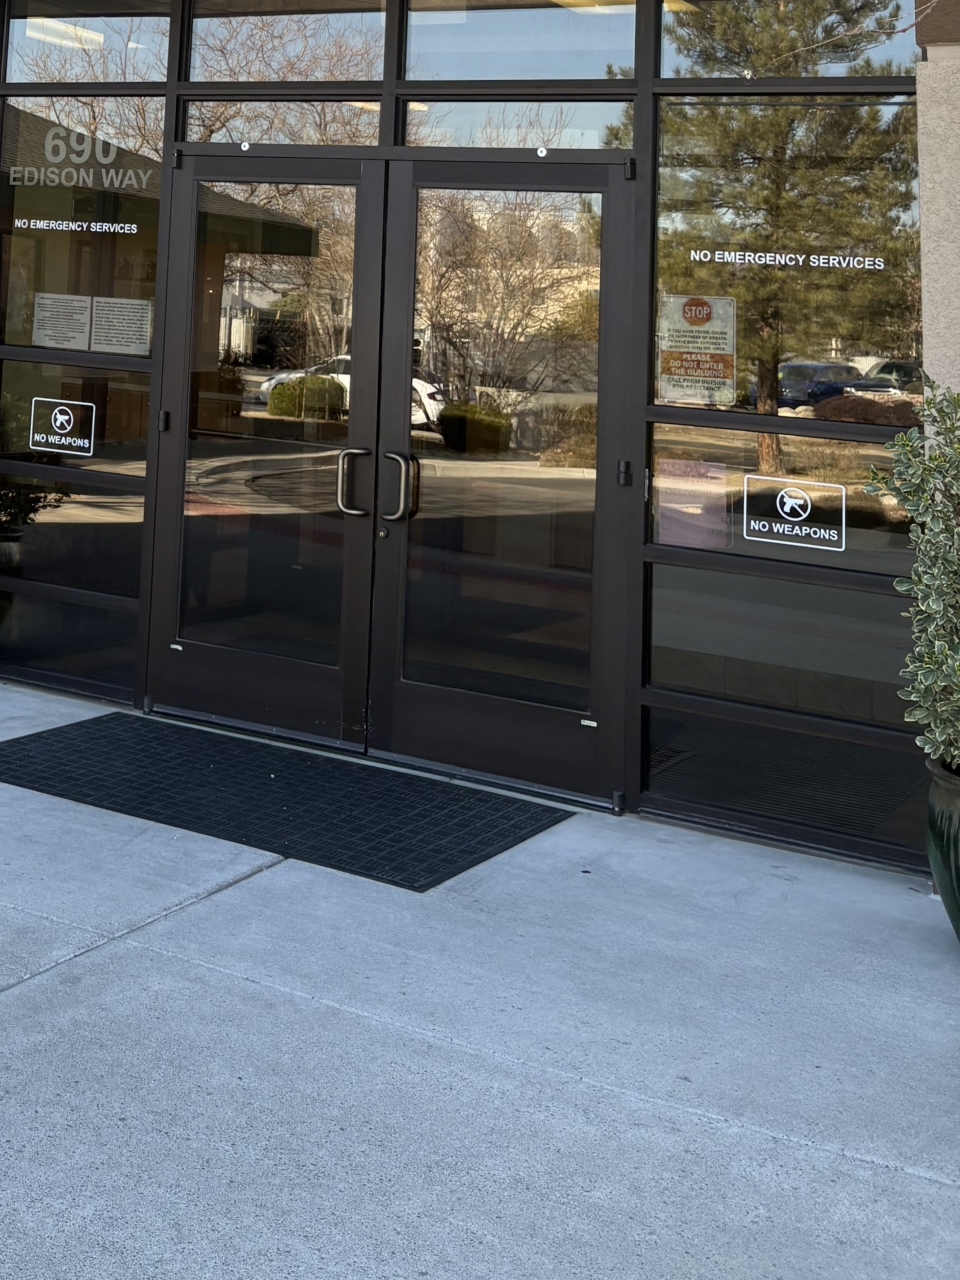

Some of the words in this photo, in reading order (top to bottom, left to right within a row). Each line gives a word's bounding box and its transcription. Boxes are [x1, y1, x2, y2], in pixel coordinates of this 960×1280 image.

[44, 126, 118, 165] 690
[9, 166, 93, 188] EDISON
[101, 168, 153, 189] WAY
[14, 219, 28, 229] NO
[30, 220, 88, 231] EMERGENCY
[90, 222, 138, 234] SERVICES
[690, 250, 711, 262] NO
[714, 250, 806, 266] EMERGENCY
[809, 255, 885, 270] SERVICES
[684, 306, 710, 318] STOP
[683, 353, 711, 361] PLEASE
[670, 367, 686, 375] THE
[687, 368, 724, 377] BUILDING
[700, 362, 724, 370] ENTER
[33, 433, 46, 443] NO
[47, 434, 90, 448] WEAPONS
[750, 519, 769, 532] NO
[772, 521, 838, 541] WEAPONS
